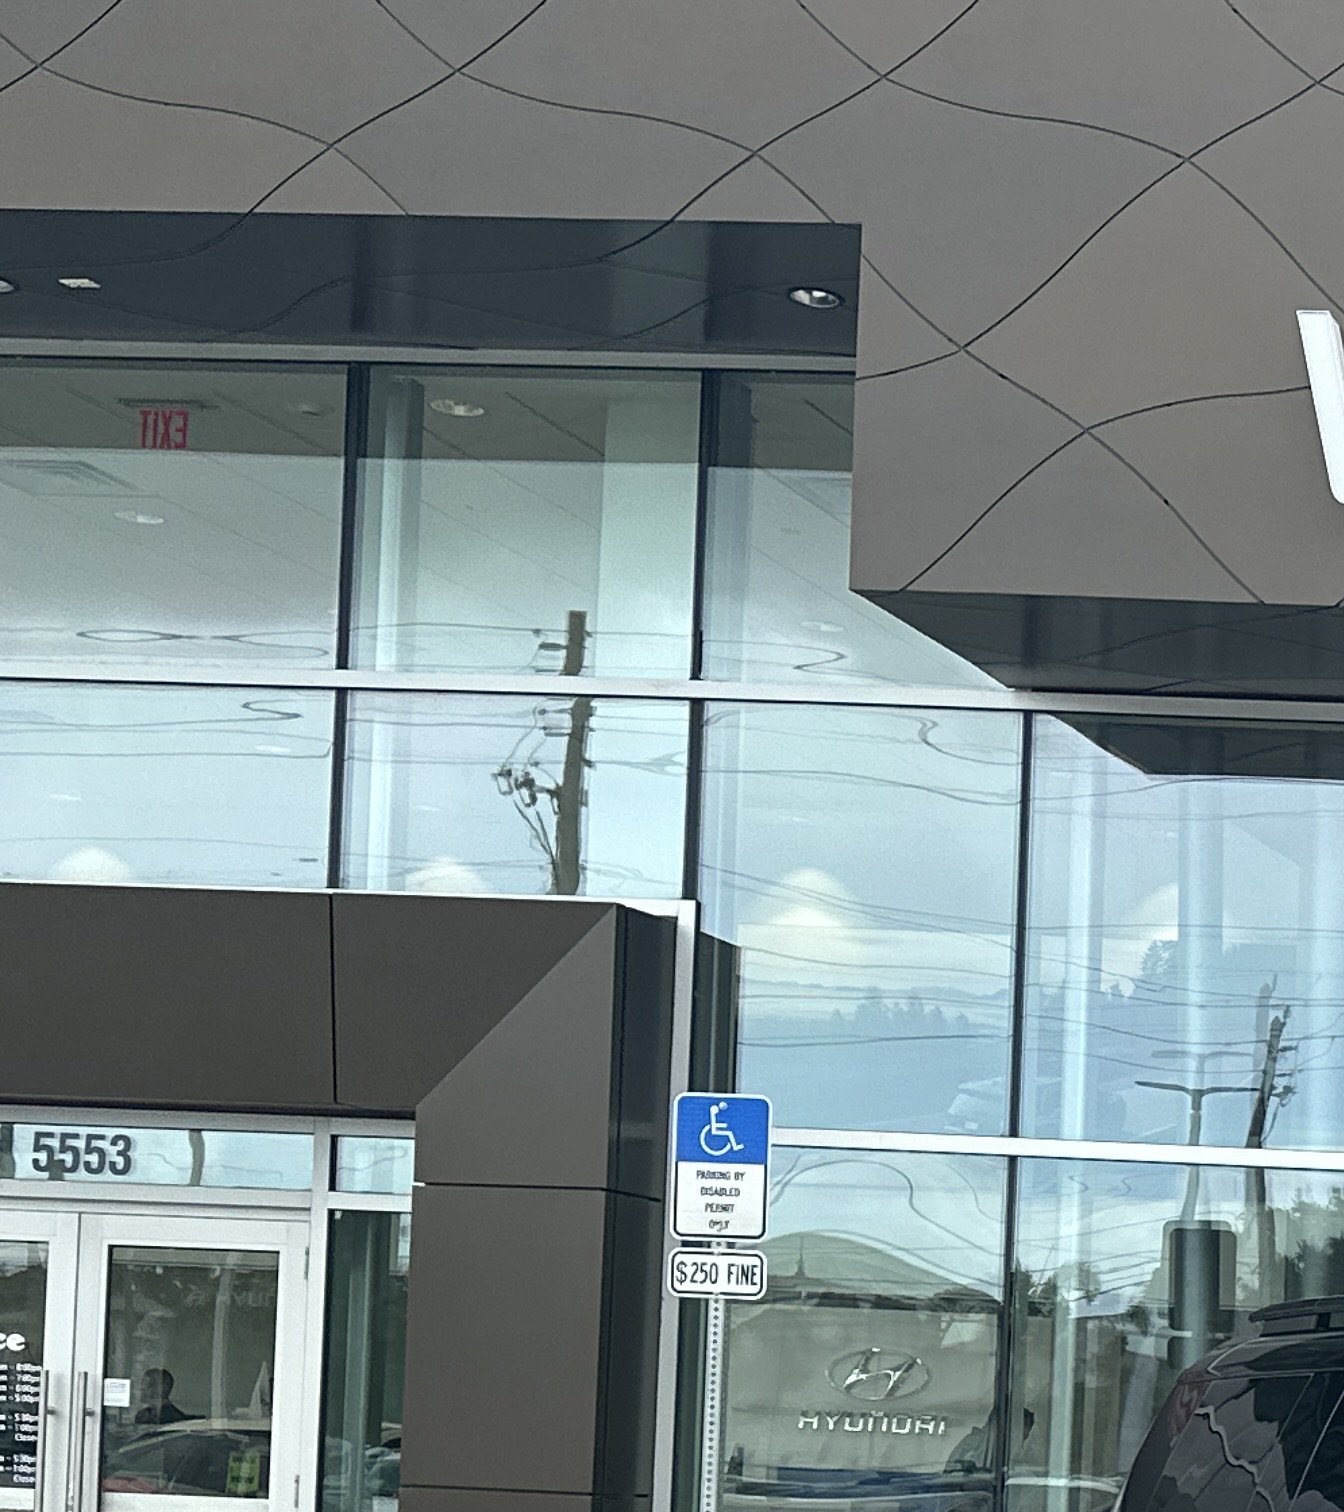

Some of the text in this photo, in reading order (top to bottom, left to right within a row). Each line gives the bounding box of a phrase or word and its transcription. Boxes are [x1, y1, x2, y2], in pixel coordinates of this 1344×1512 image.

[32, 1131, 132, 1176] 5553
[675, 1260, 759, 1286] $250 FINE
[797, 1410, 947, 1435] HYUNDAI
